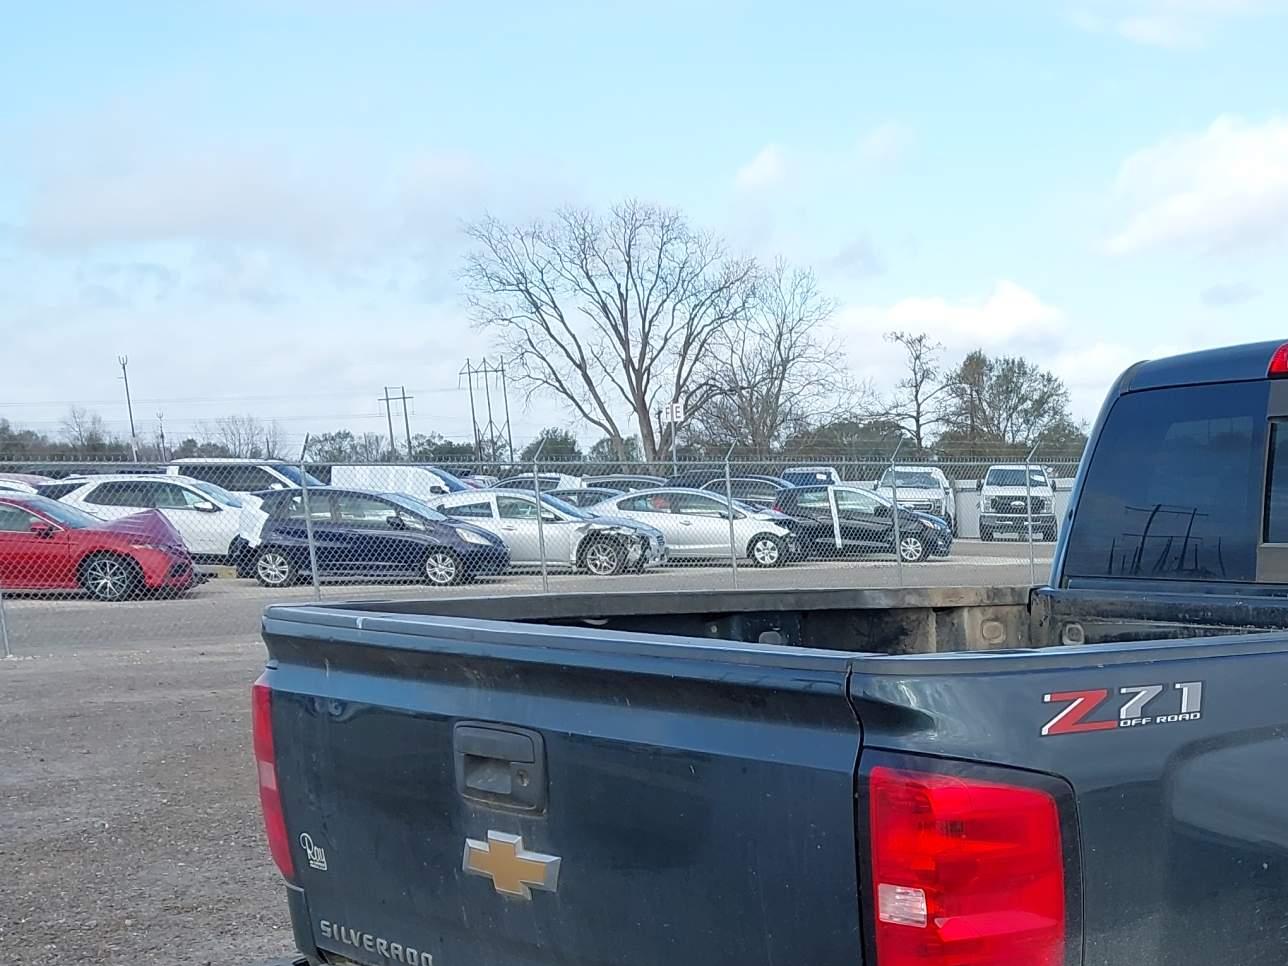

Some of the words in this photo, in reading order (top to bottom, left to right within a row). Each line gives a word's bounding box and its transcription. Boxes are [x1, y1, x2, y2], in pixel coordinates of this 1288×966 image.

[1040, 681, 1202, 736] Z71
[1119, 716, 1153, 728] OFF
[1155, 711, 1201, 724] ROAD
